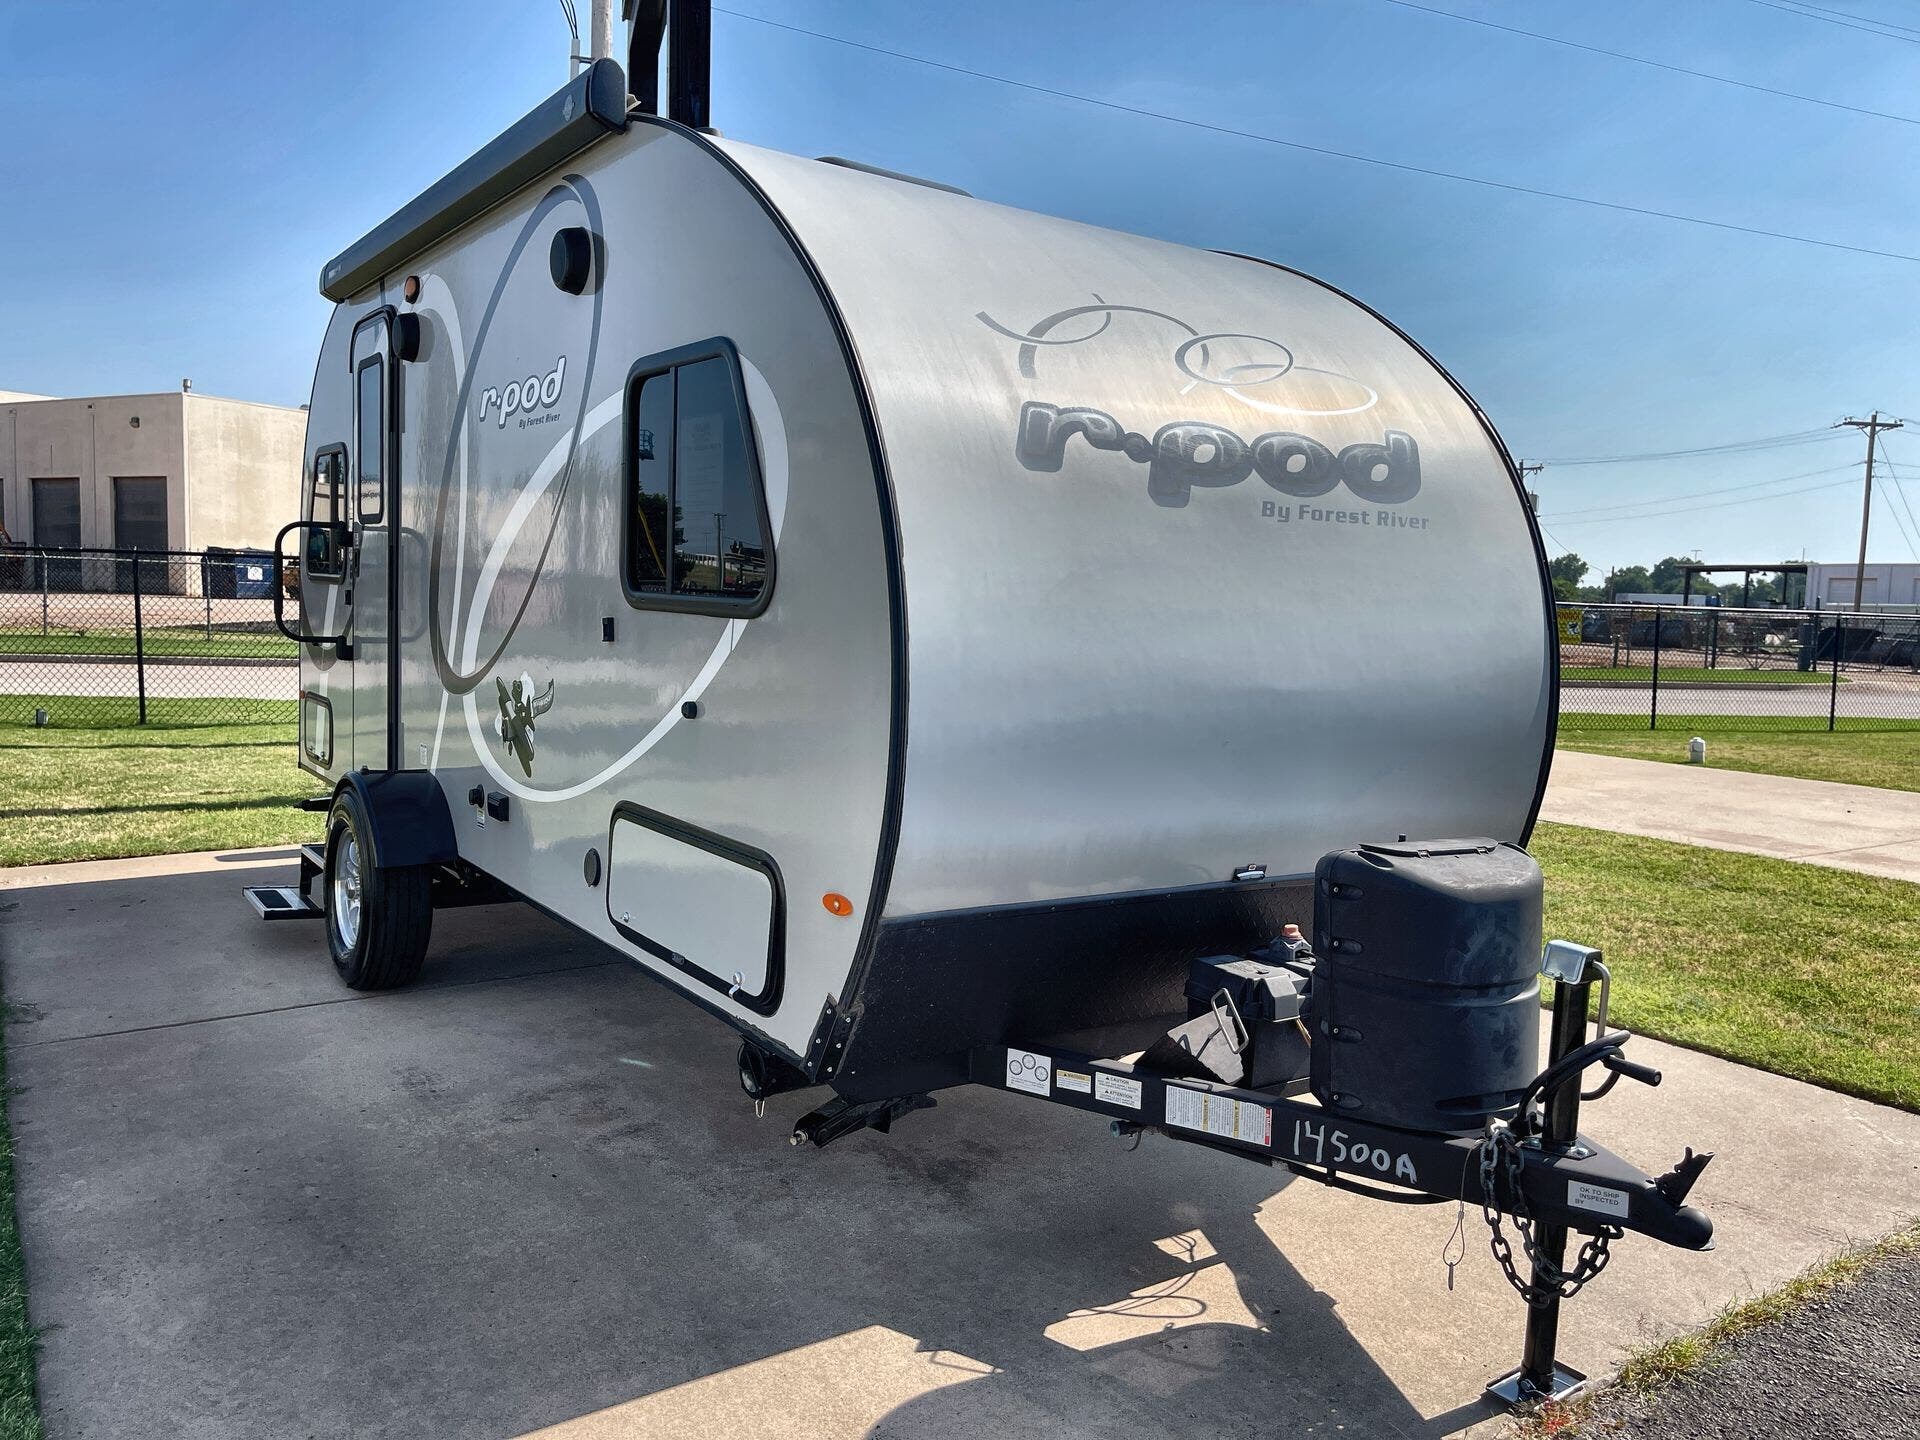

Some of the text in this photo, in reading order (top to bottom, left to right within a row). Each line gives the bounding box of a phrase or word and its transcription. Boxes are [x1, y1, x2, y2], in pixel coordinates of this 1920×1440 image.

[519, 413, 560, 429] By Forest River
[1261, 501, 1430, 530] By Forest River
[1110, 1076, 1130, 1085] CAUTION
[1109, 1090, 1133, 1099] ATTENTION
[1293, 1120, 1418, 1184] 14500A
[1579, 1186, 1590, 1194] OK
[1603, 1191, 1620, 1199] SHIP
[1579, 1193, 1619, 1206] INSPECTED
